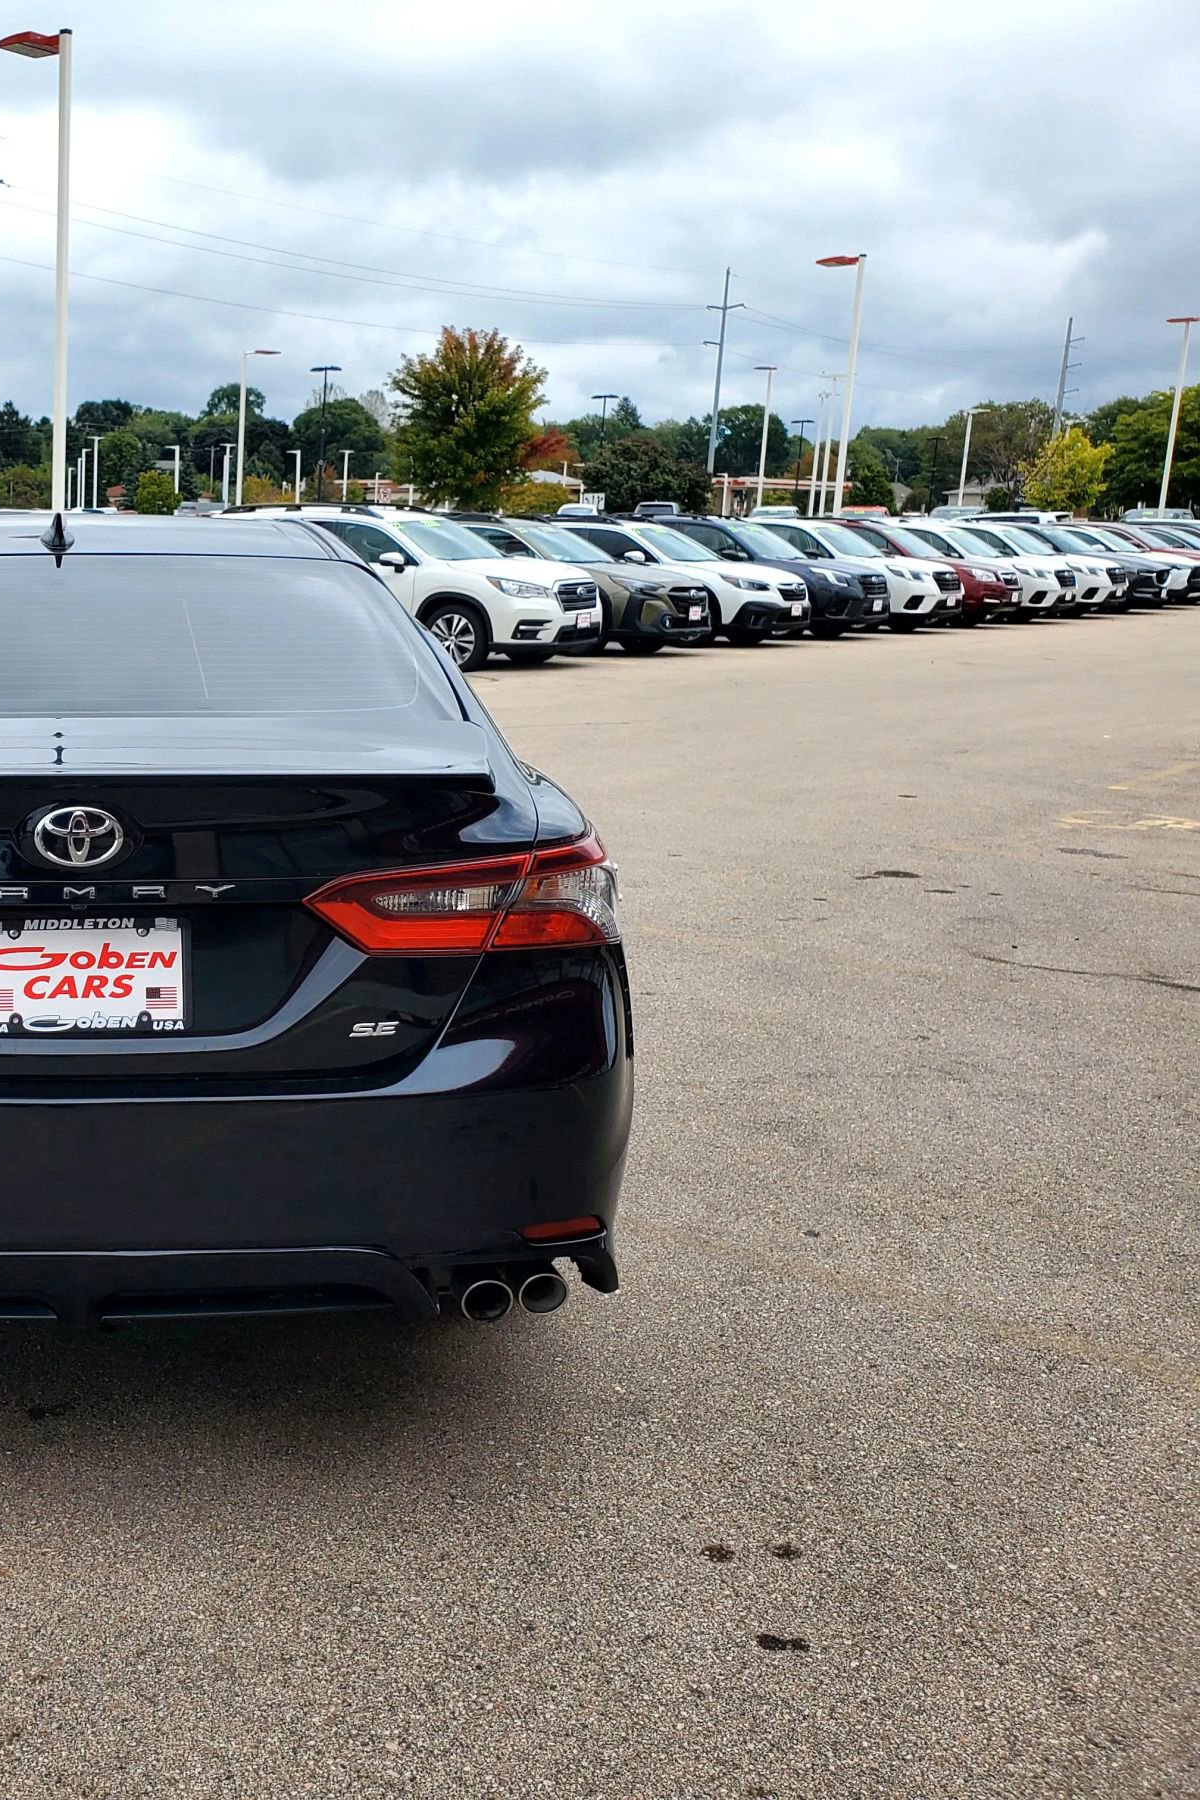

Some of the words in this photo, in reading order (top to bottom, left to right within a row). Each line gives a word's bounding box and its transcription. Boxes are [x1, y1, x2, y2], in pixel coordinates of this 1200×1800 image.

[23, 917, 135, 931] MIDDLETON
[23, 974, 136, 1000] CARS
[152, 1020, 185, 1031] USA
[348, 1020, 400, 1038] SE
